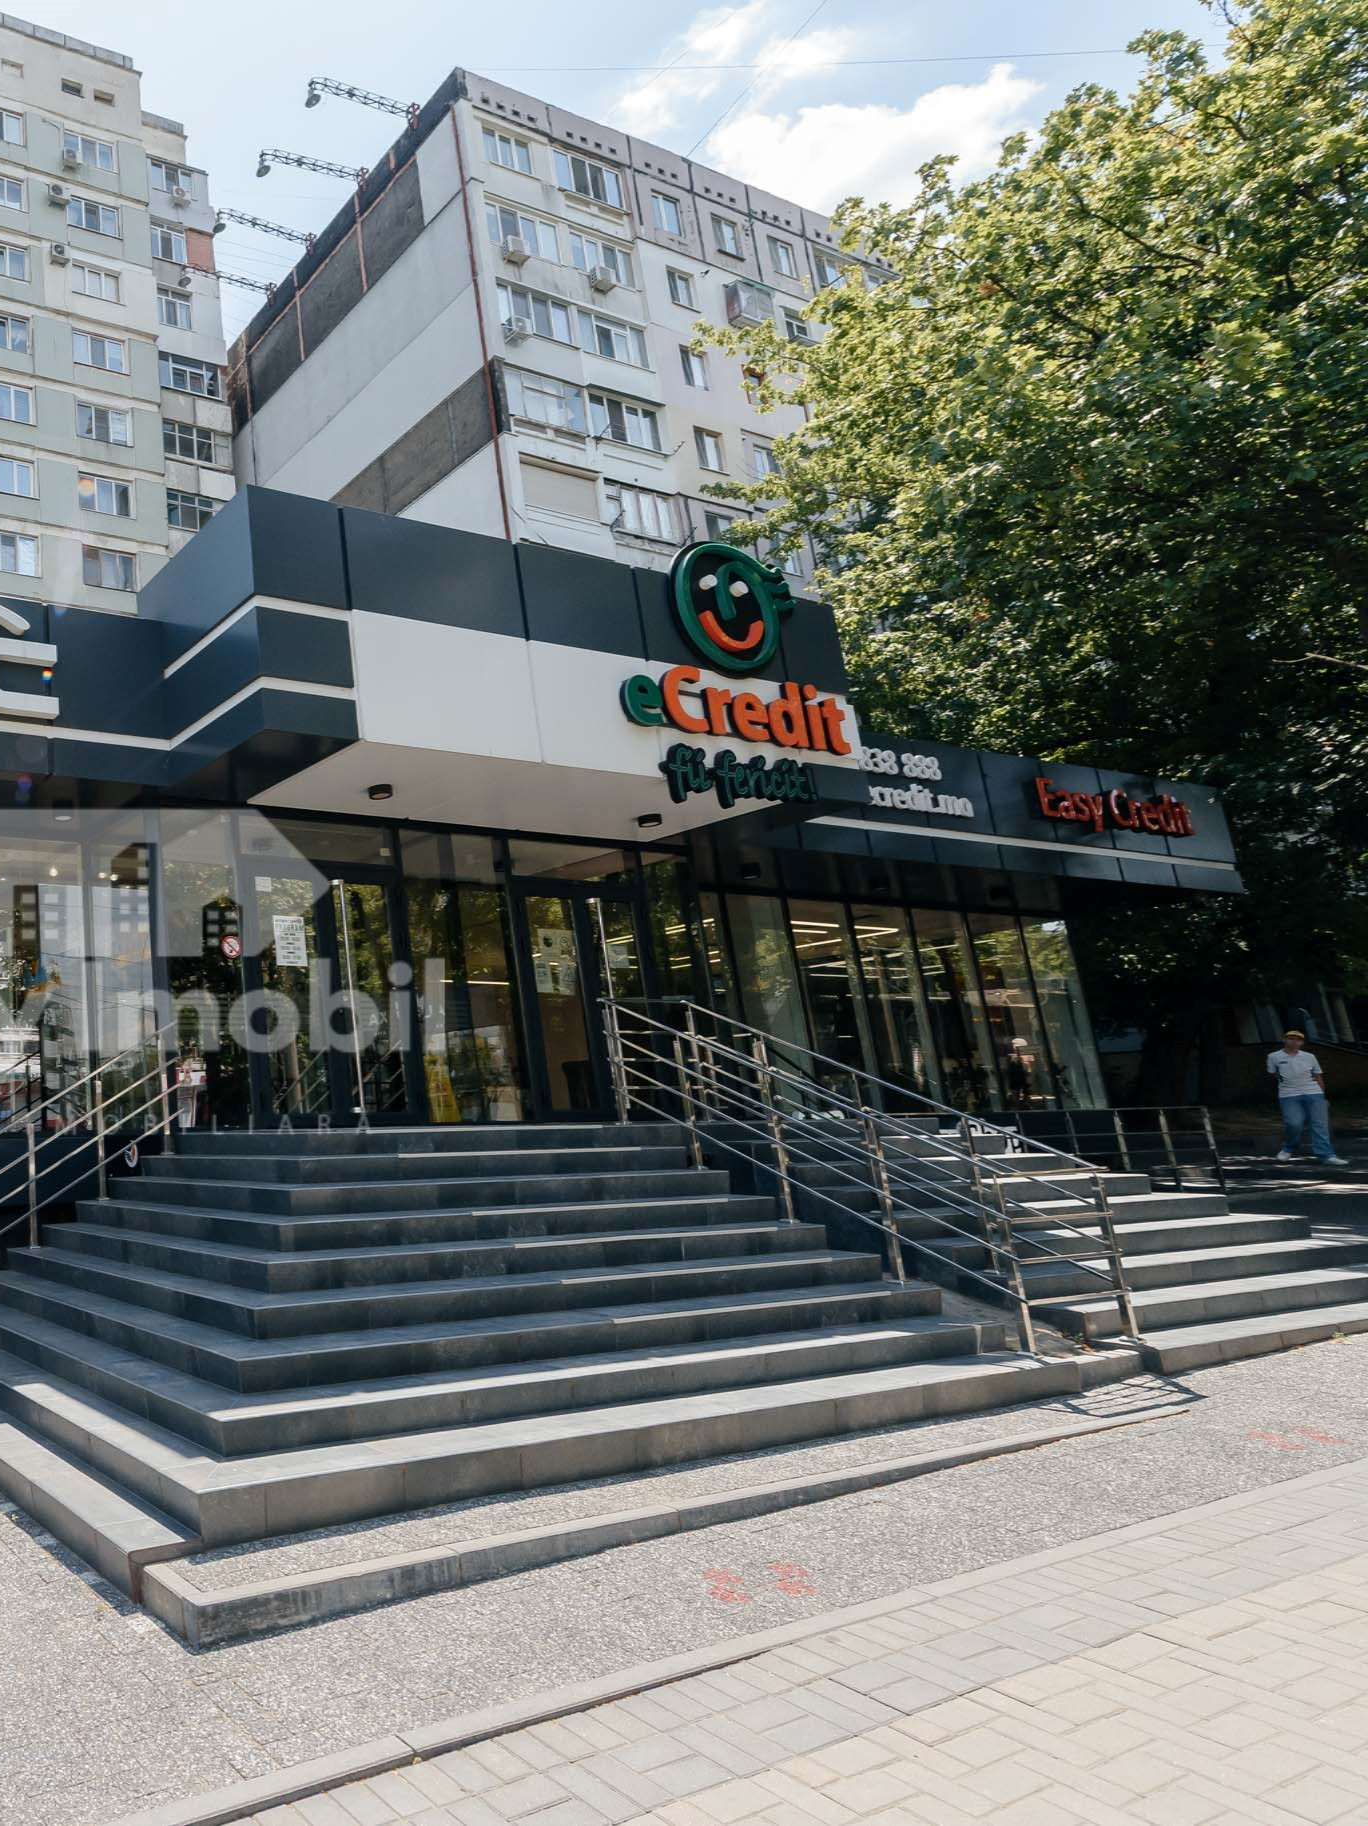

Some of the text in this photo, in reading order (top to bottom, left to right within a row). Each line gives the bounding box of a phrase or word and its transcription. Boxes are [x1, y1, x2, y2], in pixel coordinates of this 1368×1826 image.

[620, 664, 852, 756] eCredit
[901, 753, 942, 781] 888
[1035, 777, 1196, 836] Easy Credit
